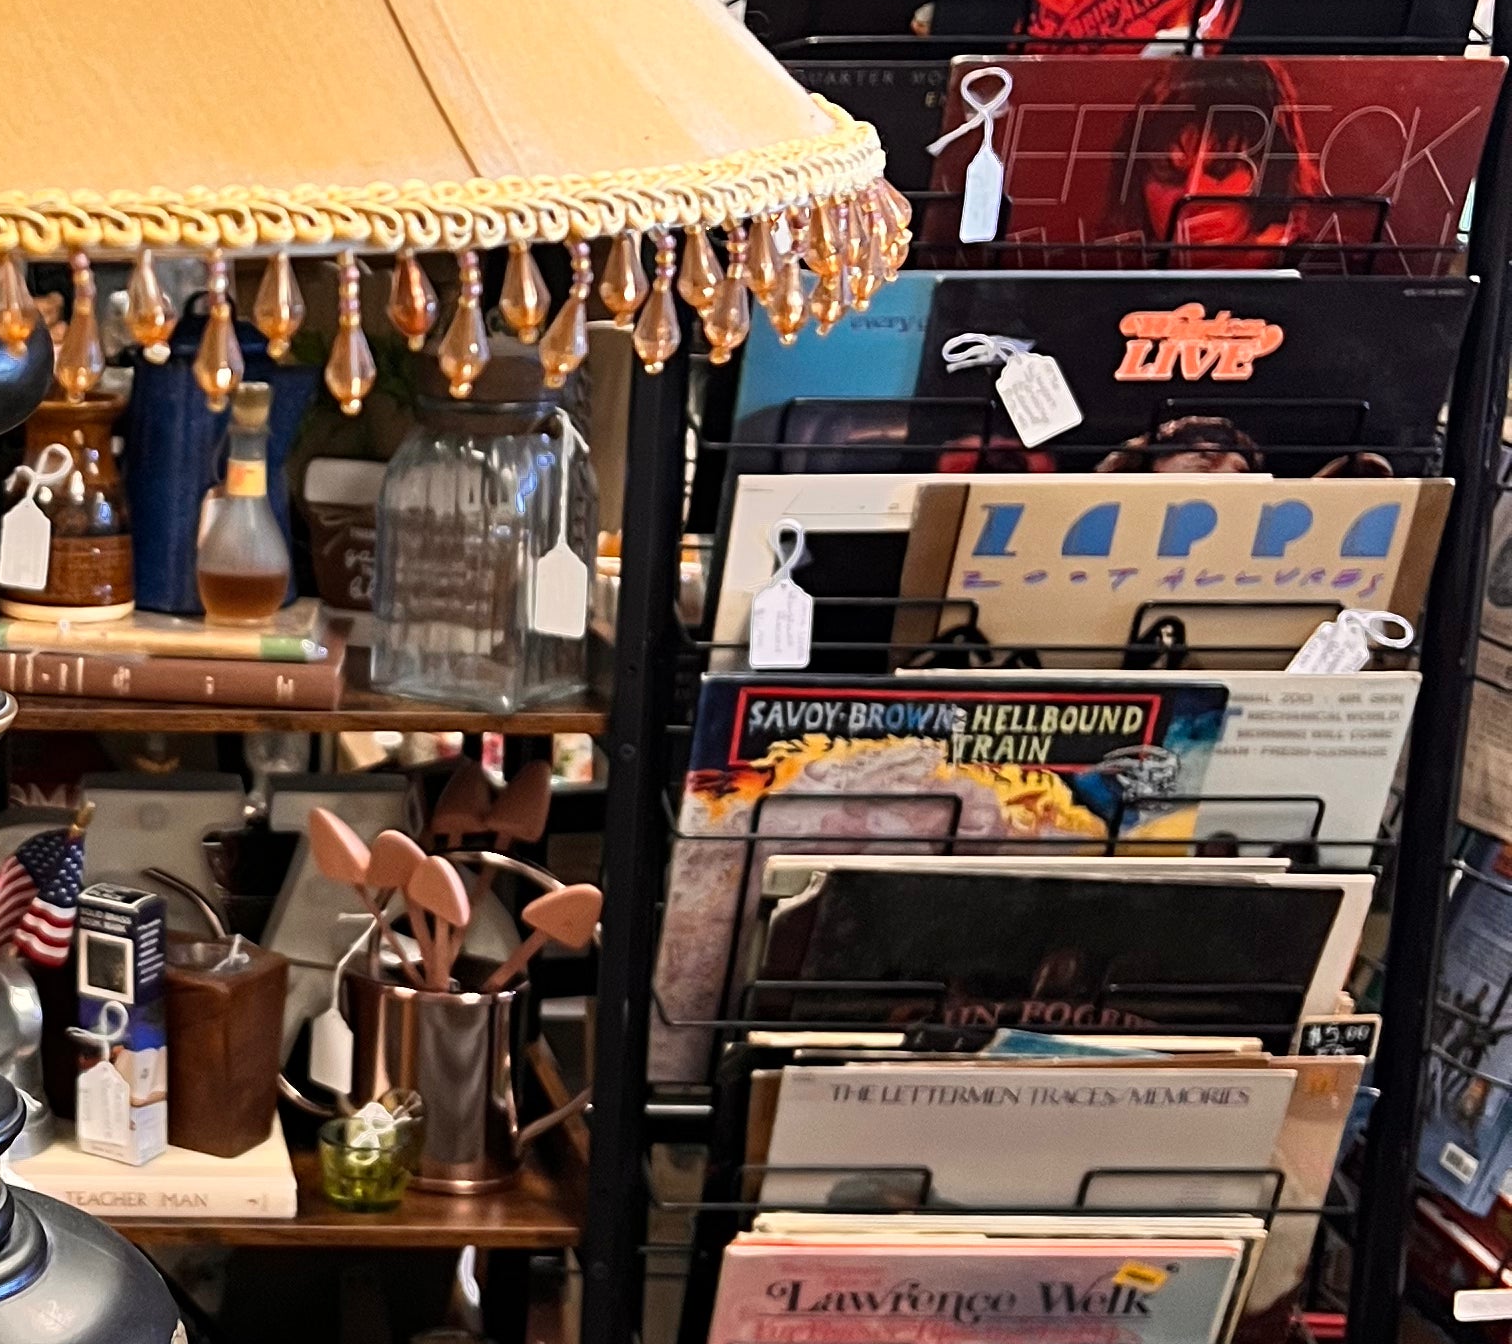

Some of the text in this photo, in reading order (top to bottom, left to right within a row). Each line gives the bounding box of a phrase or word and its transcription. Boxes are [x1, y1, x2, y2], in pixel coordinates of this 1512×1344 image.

[1115, 339, 1254, 382] LIVE
[971, 498, 1402, 560] ZAPPA
[971, 703, 1144, 735] HELLBOUND
[953, 733, 1053, 765] TRAIN
[830, 1082, 875, 1103] THE
[881, 1083, 1021, 1105] LETTERMEN
[66, 1190, 210, 1207] TEACHER MAN
[765, 1271, 1156, 1325] Lawrence Welk
